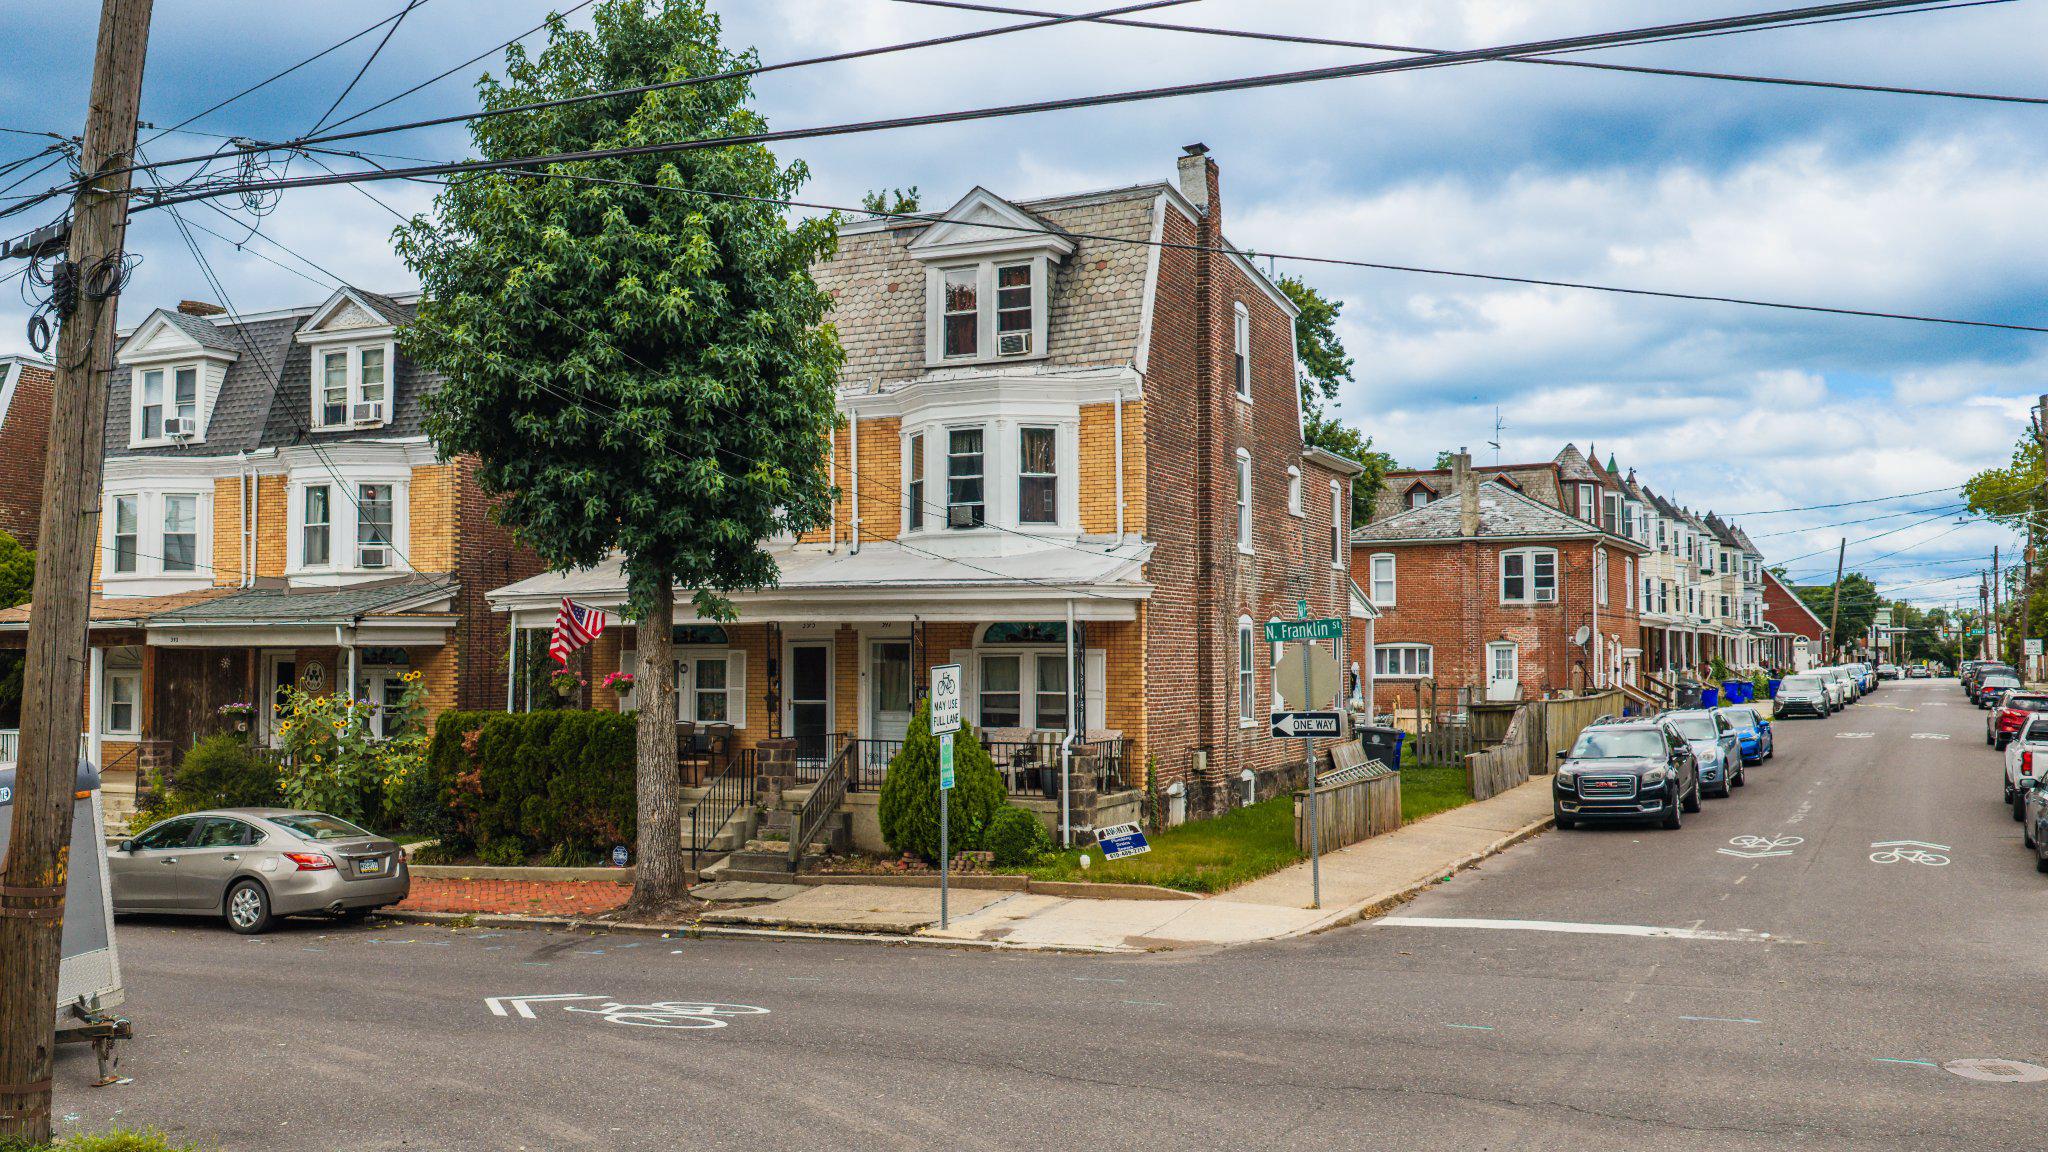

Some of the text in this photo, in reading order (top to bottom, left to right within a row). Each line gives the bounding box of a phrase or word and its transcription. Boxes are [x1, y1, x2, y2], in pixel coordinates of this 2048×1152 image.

[1266, 620, 1340, 640] N. Franklin St
[934, 699, 958, 712] MAY USE
[934, 714, 959, 727] FULL LANE
[1294, 720, 1334, 730] ONE WAY
